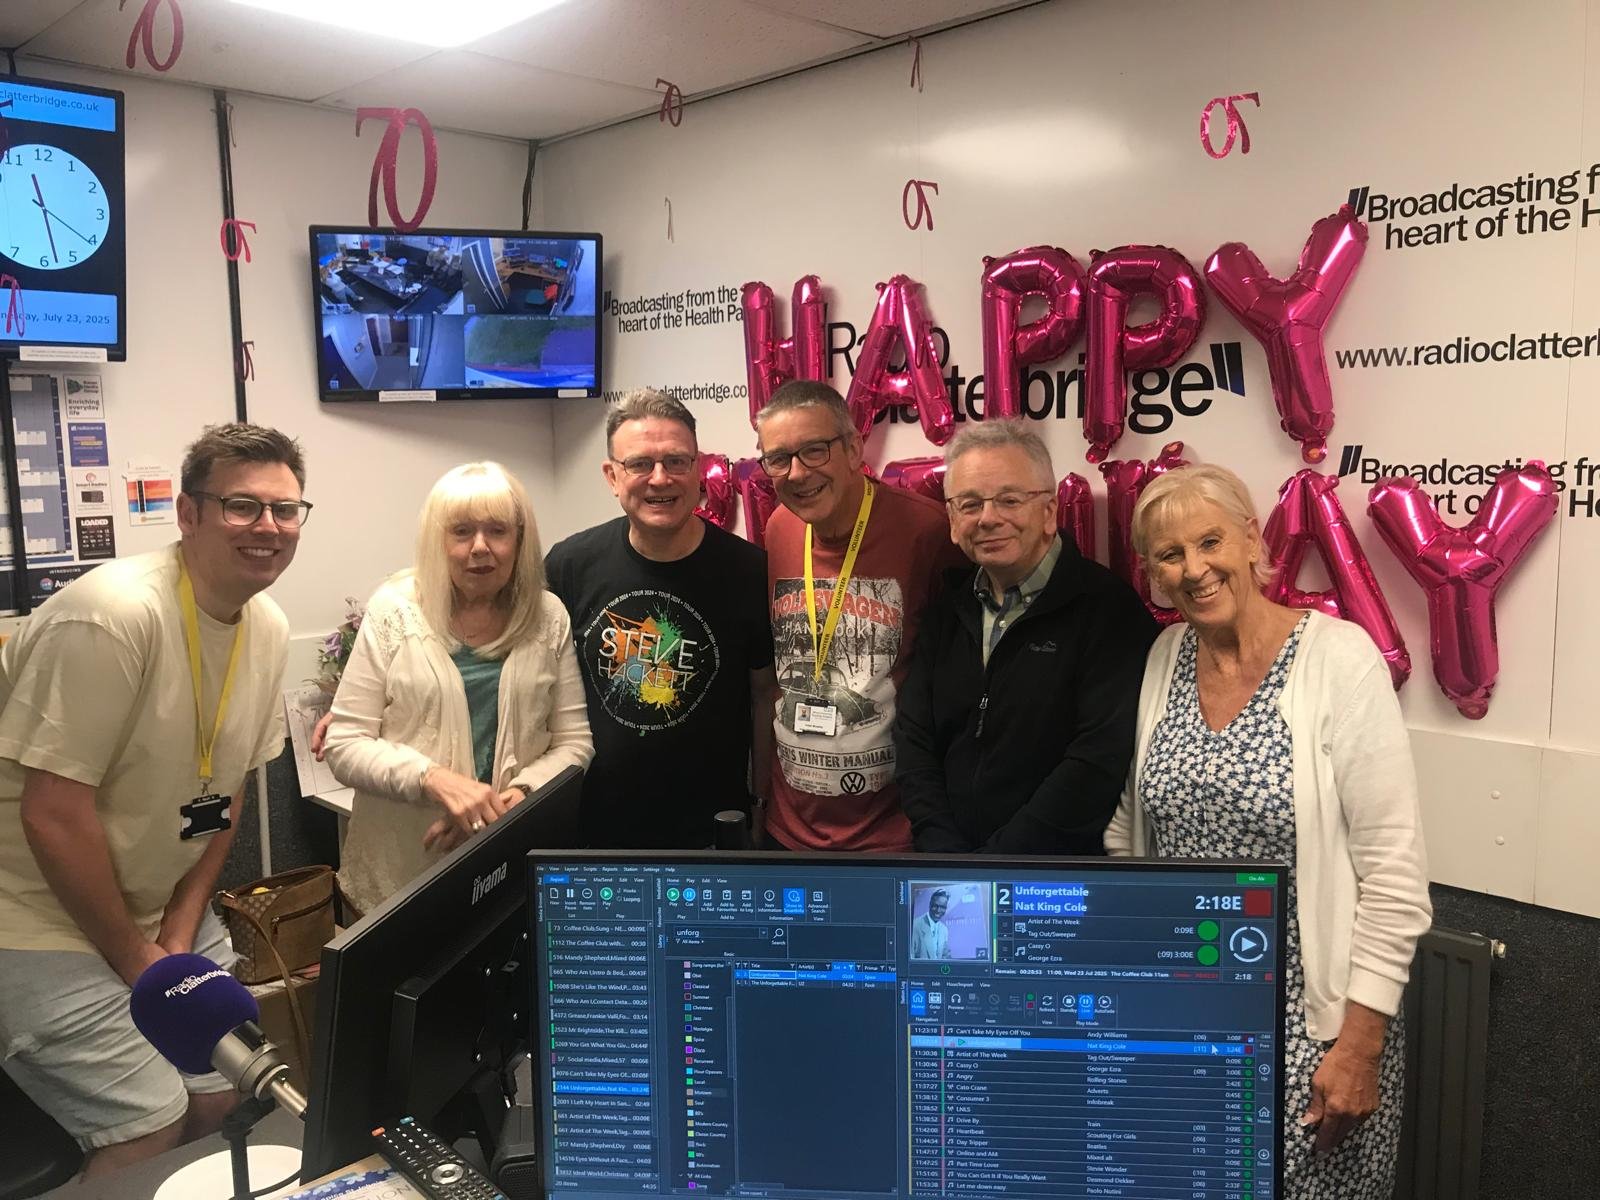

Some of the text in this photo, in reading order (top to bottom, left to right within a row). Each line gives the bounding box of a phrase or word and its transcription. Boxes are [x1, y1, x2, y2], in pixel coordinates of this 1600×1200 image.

[34, 148, 53, 162] 12
[68, 160, 76, 172] 1
[355, 107, 438, 233] 70
[88, 182, 97, 194] 2
[1368, 170, 1581, 223] Broadcasting
[96, 208, 105, 221] 3
[1386, 215, 1468, 250] heart
[1475, 208, 1509, 240] of
[1515, 205, 1571, 235] the
[88, 234, 98, 246] 4
[10, 246, 20, 258] 7
[68, 250, 77, 263] 5
[40, 256, 49, 268] 6
[611, 285, 738, 316] Broadcasting from the
[43, 312, 62, 323] July
[66, 314, 81, 324] 23,
[86, 315, 110, 325] 2025
[618, 304, 743, 333] heart of the Health Pa
[742, 203, 1369, 463] HAPPY
[81, 519, 109, 527] LOADED
[850, 520, 865, 552] VOLUNTEER
[833, 577, 847, 610] VOLUNTEER
[784, 620, 871, 640] HANDOOK
[598, 627, 698, 670] STEVE
[597, 658, 695, 691] HACKETT
[798, 750, 840, 768] WINTER
[843, 748, 895, 768] MANUAL
[471, 861, 508, 906] iiyama
[999, 886, 1090, 905] 2 Unforgettable
[1015, 902, 1087, 914] Nat King Cole
[1195, 895, 1242, 910] 2:18E
[676, 929, 700, 938] unforg
[1028, 931, 1077, 940] Tag Out/Sweeper
[1174, 926, 1194, 934] 0:09E
[1028, 943, 1044, 951] Cassy
[1028, 954, 1049, 963] George
[1157, 951, 1195, 960] (:09) 3:00E
[170, 975, 197, 996] Radio
[985, 1029, 994, 1037] My
[995, 1029, 1009, 1037] Eyes
[1087, 1132, 1112, 1140] Scouting
